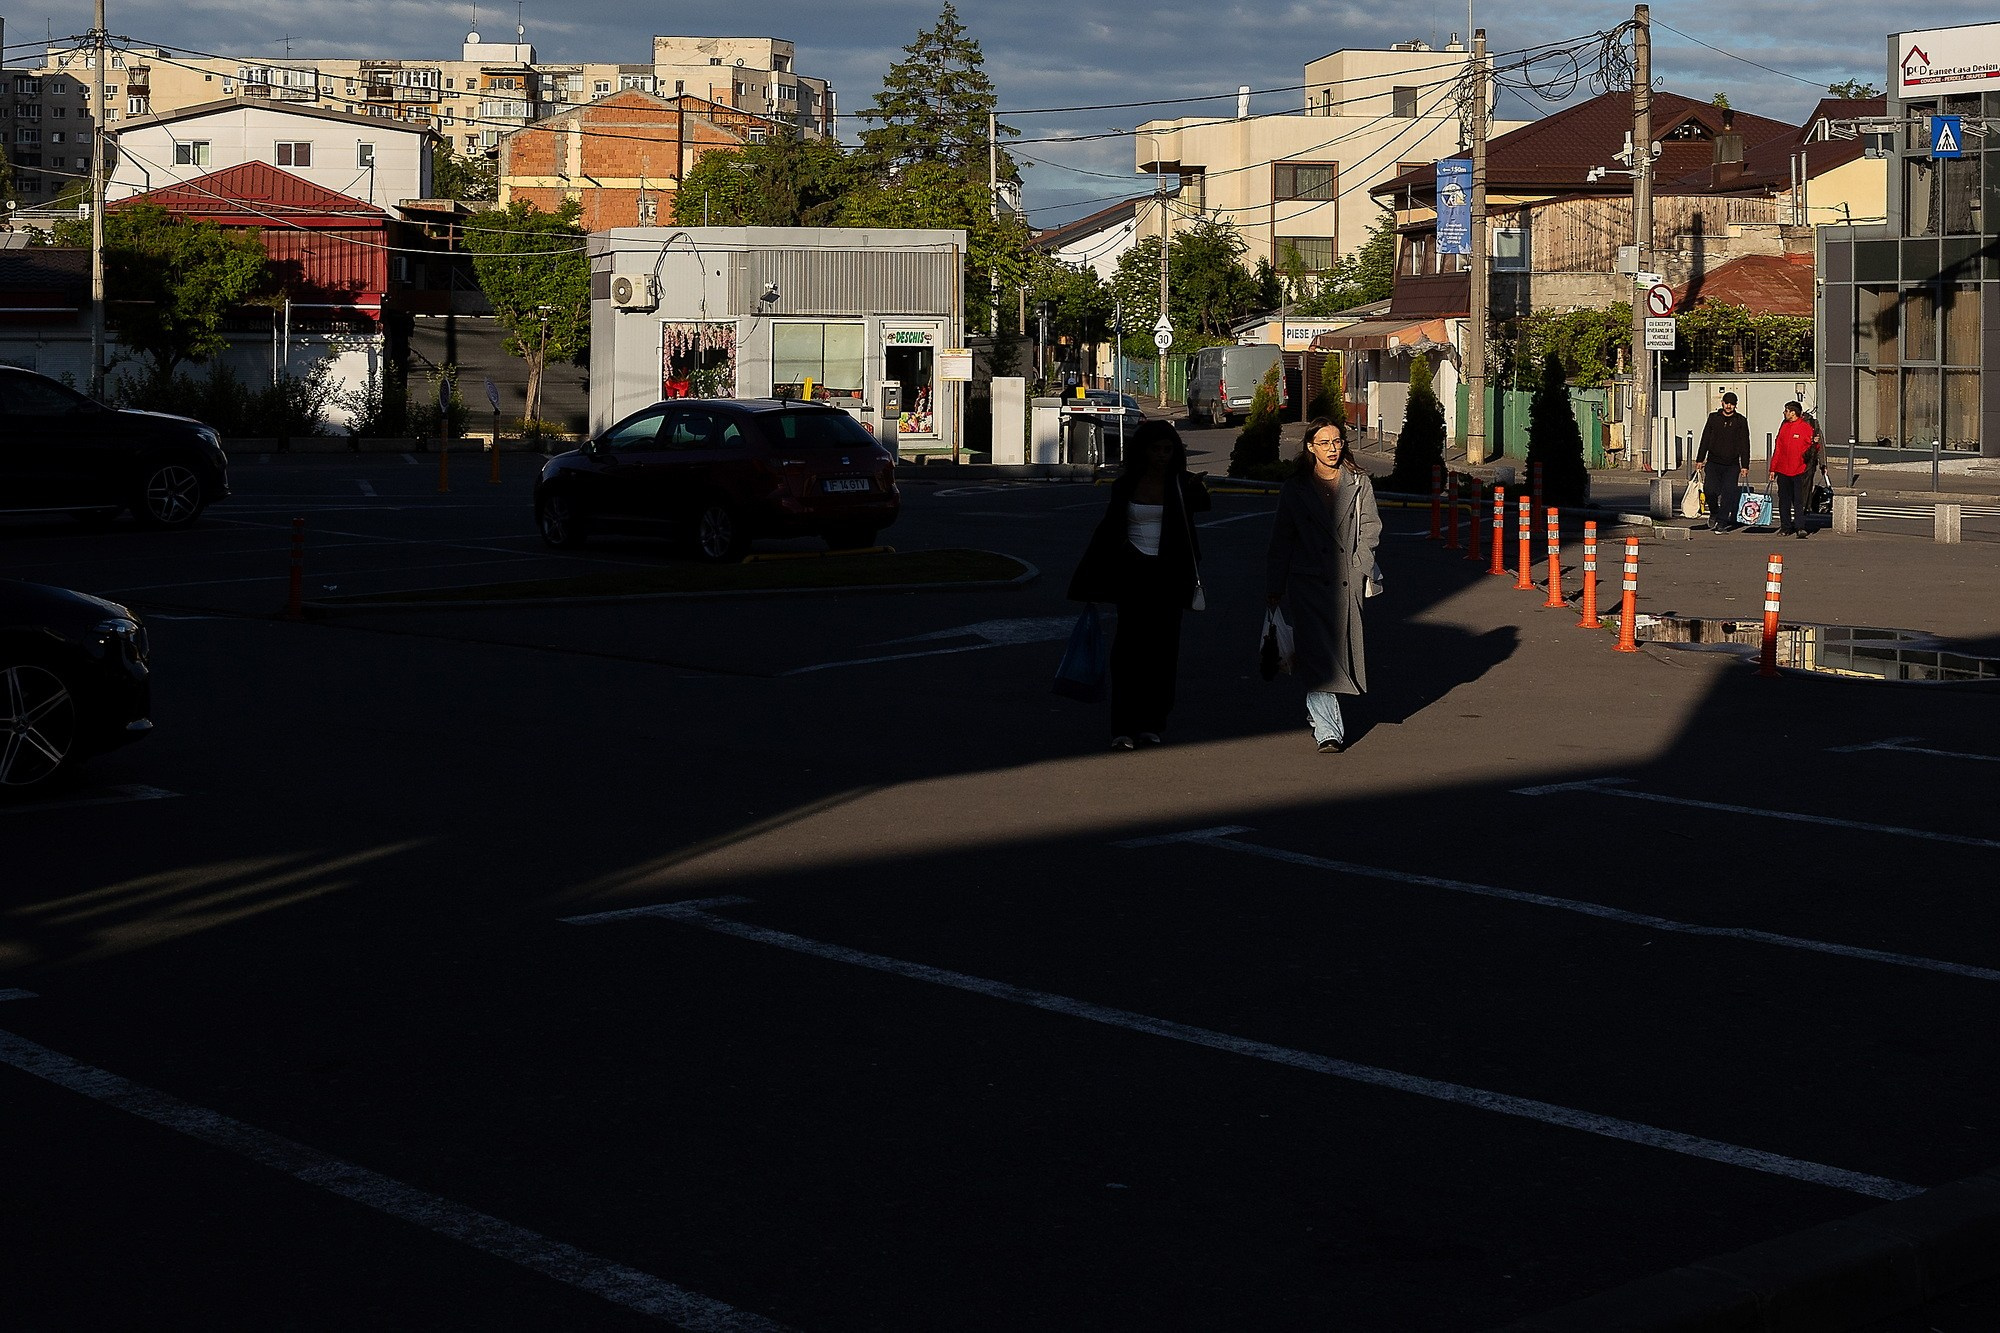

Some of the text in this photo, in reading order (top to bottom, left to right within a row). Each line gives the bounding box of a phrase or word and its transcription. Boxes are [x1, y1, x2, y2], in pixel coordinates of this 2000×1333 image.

[1953, 66, 1971, 74] Casa
[1972, 63, 1998, 72] Design
[248, 320, 296, 330] SANIE
[307, 320, 357, 331] ELECTRICE
[896, 331, 925, 343] DESCHIS
[1158, 335, 1168, 344] 30
[1286, 329, 1309, 339] PIESE
